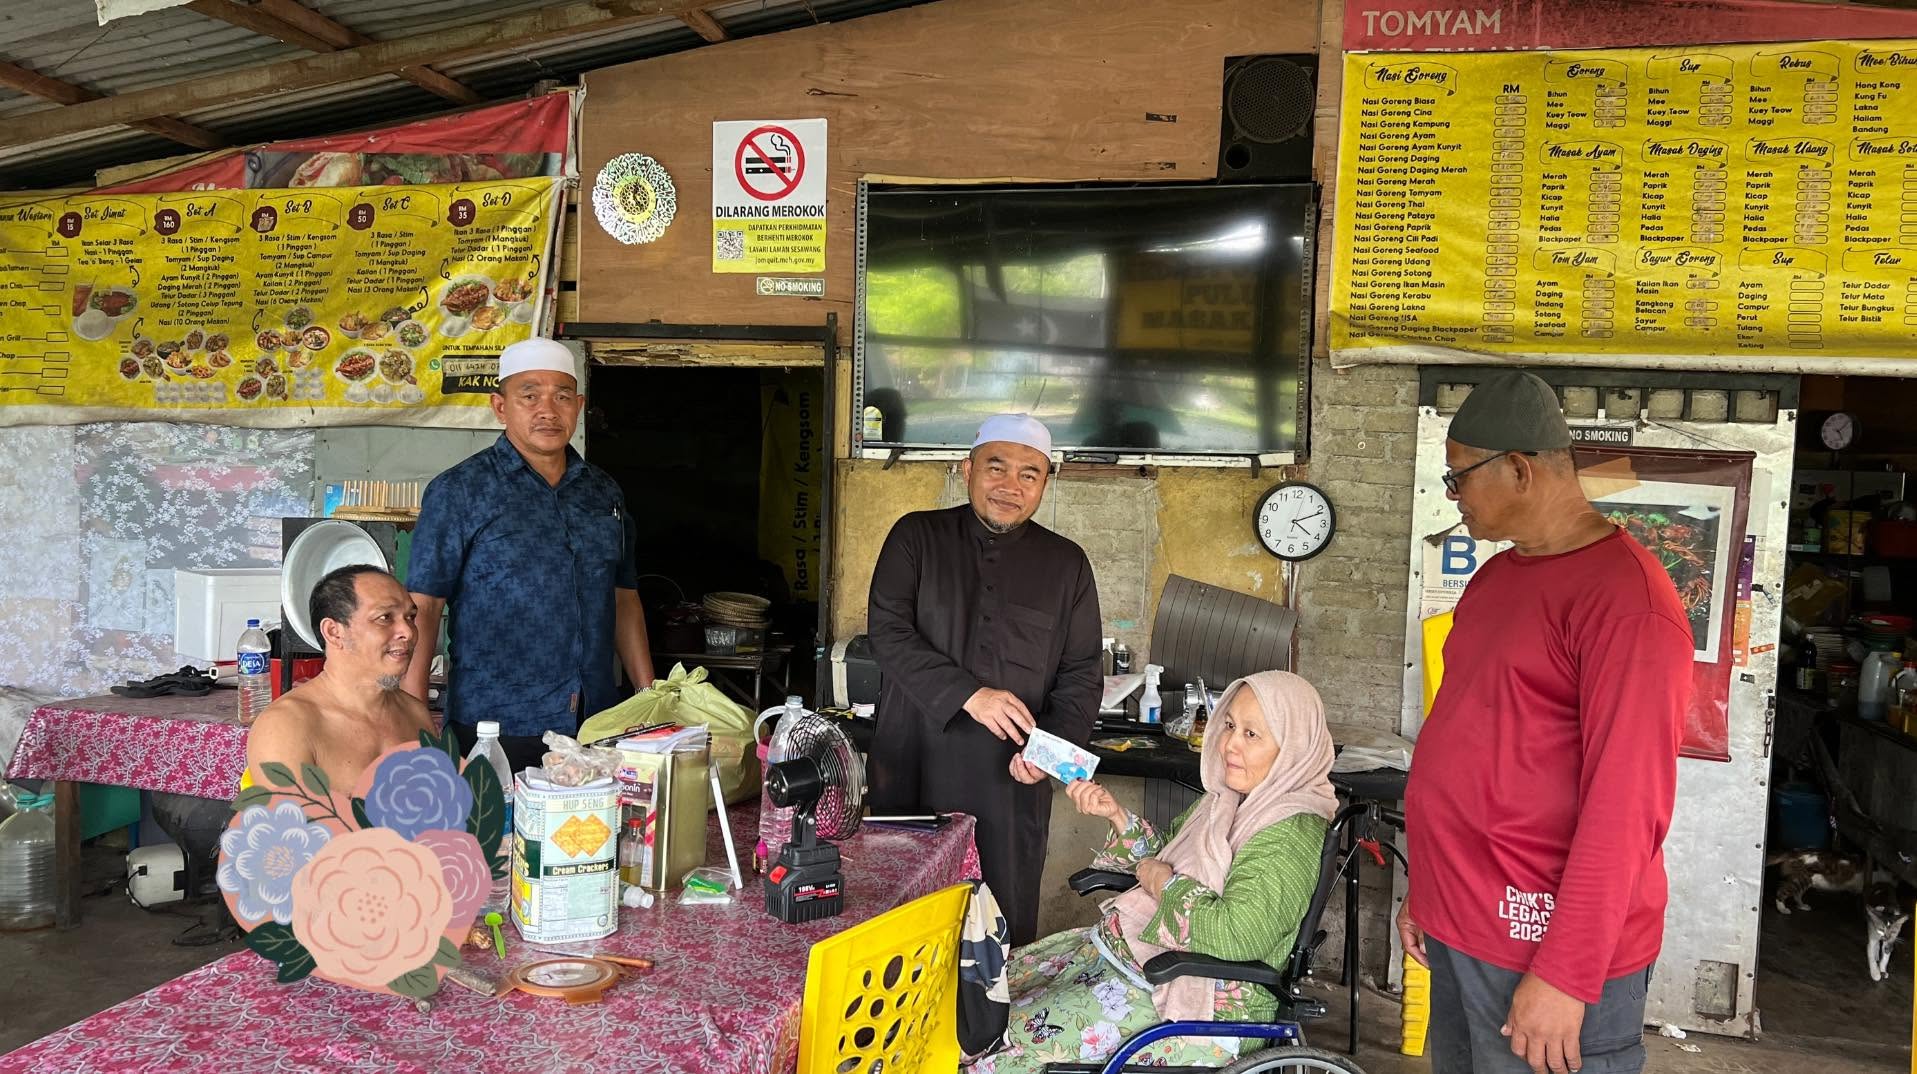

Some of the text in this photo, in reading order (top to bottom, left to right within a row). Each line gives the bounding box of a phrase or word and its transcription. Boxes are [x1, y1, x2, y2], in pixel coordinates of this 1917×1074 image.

[1362, 9, 1502, 36] TOMYAM
[1680, 59, 1701, 72] Sup
[1780, 56, 1812, 69] Rebus
[1375, 67, 1448, 83] Nasi Goreng
[1567, 64, 1605, 78] Goreng
[1503, 84, 1520, 93] RM
[1855, 82, 1877, 90] Hong
[1855, 93, 1874, 101] Kung
[1381, 109, 1411, 117] Goreng
[1546, 122, 1570, 130] Maggi
[1852, 126, 1888, 134] Bandung
[1379, 132, 1410, 140] Goreng
[1412, 132, 1435, 140] Ayam
[1548, 145, 1616, 159] Masak Ayam
[1648, 142, 1723, 156] Masak Daging
[1752, 141, 1828, 156] Masak Udang
[1856, 142, 1896, 154] Masak
[1378, 155, 1408, 163] Goreng
[1411, 155, 1439, 163] Daging
[383, 196, 410, 210] Set C
[482, 192, 512, 207] Set D
[84, 206, 127, 220] Set Jimat
[186, 203, 216, 217] Set A
[285, 200, 299, 214] Set
[715, 205, 824, 218] DILARANG MEROKOK
[17, 208, 52, 222] Western
[210, 237, 240, 245] Kengsom
[165, 256, 192, 264] Tomyam
[197, 255, 209, 264] Sup
[211, 255, 234, 263] Daging
[477, 254, 502, 264] Orang
[1552, 251, 1598, 266] Tom Yam
[1641, 251, 1716, 266] Sayur Goreng
[1773, 252, 1795, 266] Sup
[1874, 253, 1901, 265] Telur
[775, 282, 822, 292] NO SMOKING
[1861, 304, 1894, 312] Bungkus
[458, 376, 480, 387] KAK
[796, 392, 814, 473] Kengsom
[1585, 430, 1628, 442] SMOKING
[1280, 493, 1288, 502] 11
[1292, 490, 1303, 499] 12
[793, 491, 808, 529] Stim
[1268, 503, 1278, 511] 10
[1317, 505, 1323, 514] 2
[1262, 515, 1268, 523] 9
[1320, 520, 1326, 528] 3
[1265, 529, 1271, 538] 8
[1288, 544, 1294, 553] 6
[1303, 542, 1308, 550] 5
[1442, 536, 1477, 575] B
[794, 549, 807, 591] Rasa
[563, 799, 604, 810] HUP SENG
[552, 862, 609, 876] Cream Crackers
[1498, 901, 1553, 925] LEGAC
